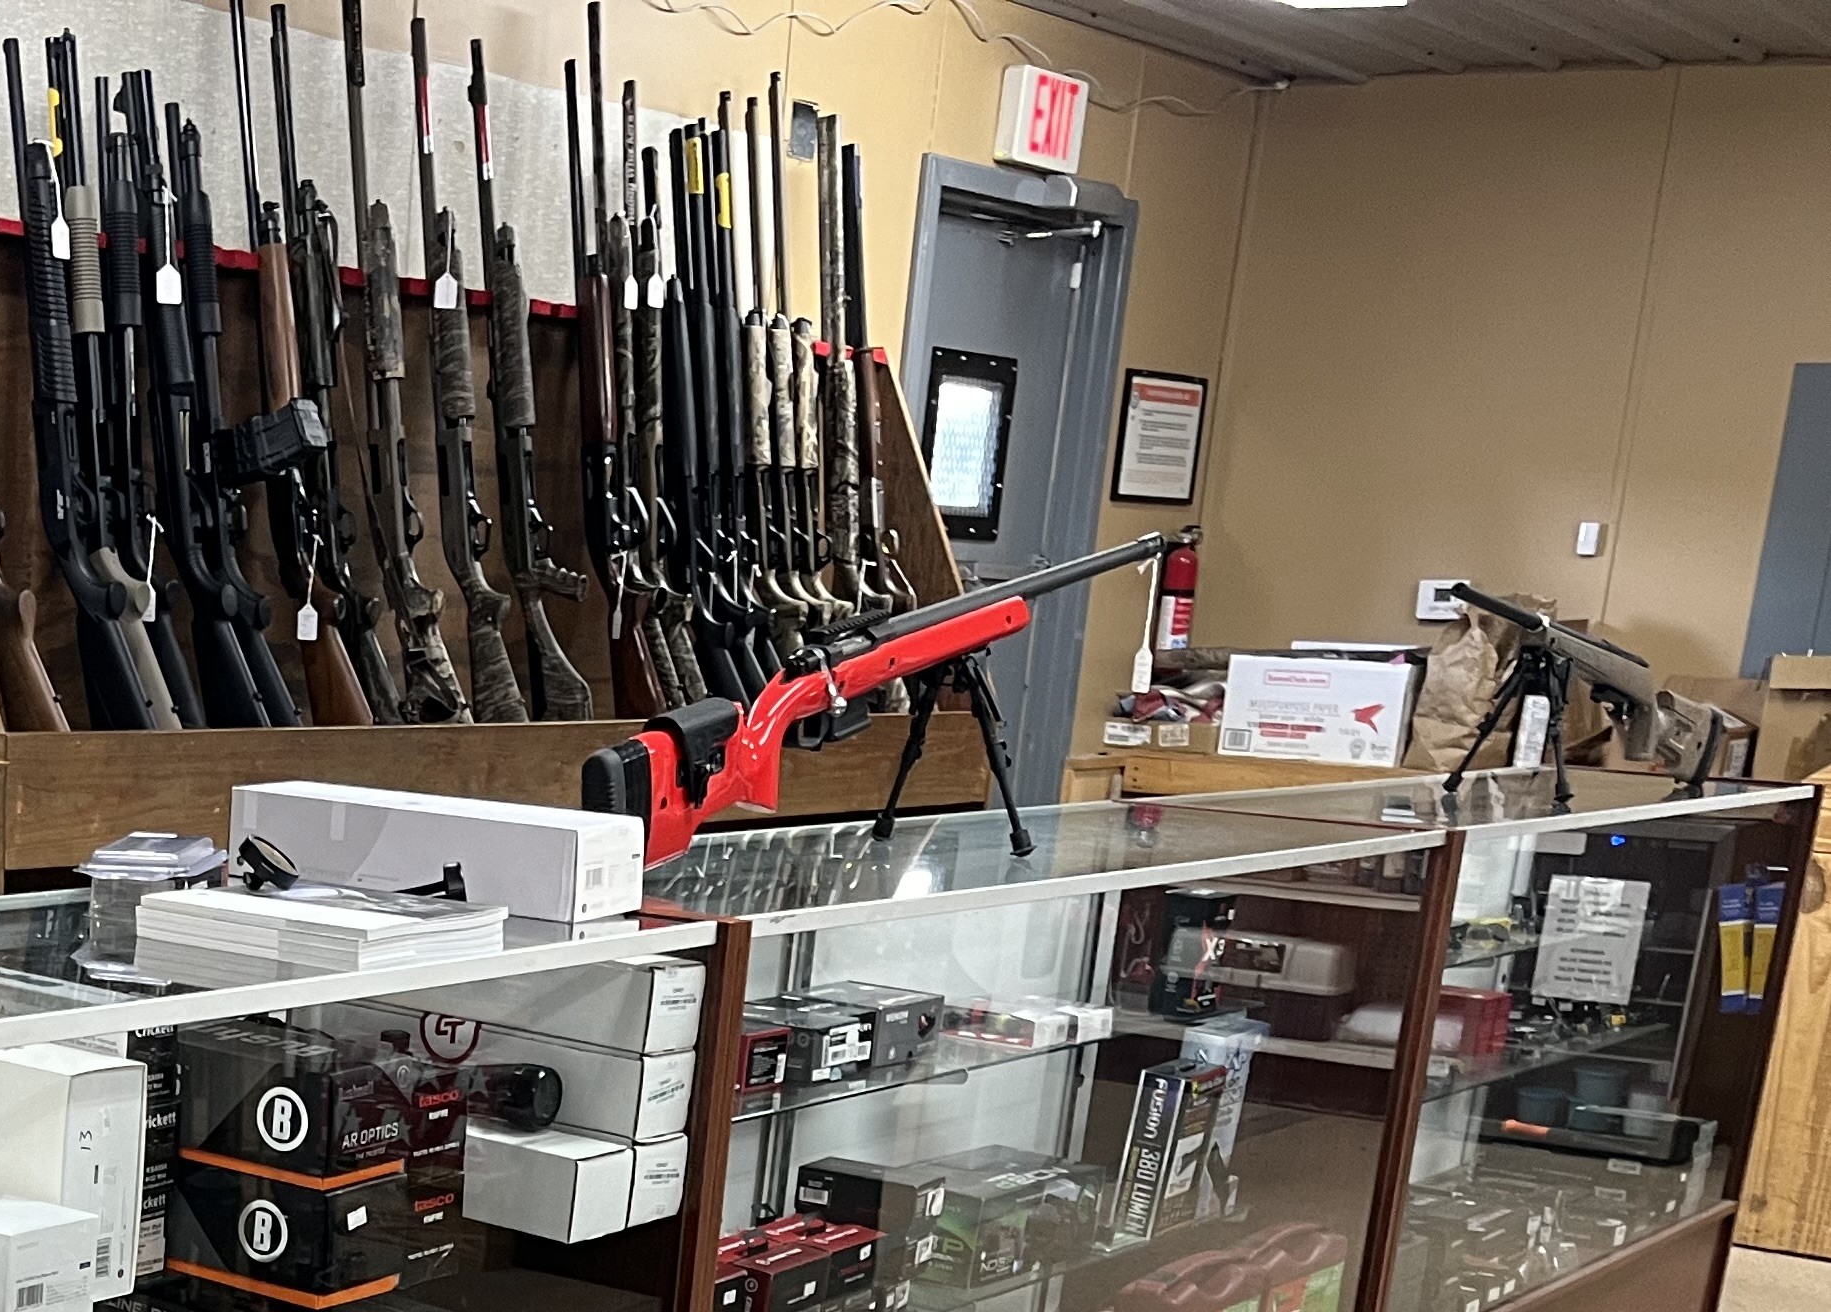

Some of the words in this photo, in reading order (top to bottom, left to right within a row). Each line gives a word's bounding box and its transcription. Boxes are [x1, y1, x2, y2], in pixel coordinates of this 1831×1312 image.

[1028, 74, 1080, 161] EXIT
[419, 1089, 461, 1108] tasco
[1143, 1077, 1169, 1140] FUSION
[145, 1109, 177, 1130] rickett
[271, 1097, 293, 1141] B
[341, 1131, 358, 1151] AR
[360, 1121, 400, 1147] OPTICS
[1136, 1147, 1162, 1182] 380
[142, 1193, 167, 1210] ckett
[414, 1192, 455, 1213] tasco
[252, 1210, 272, 1252] B
